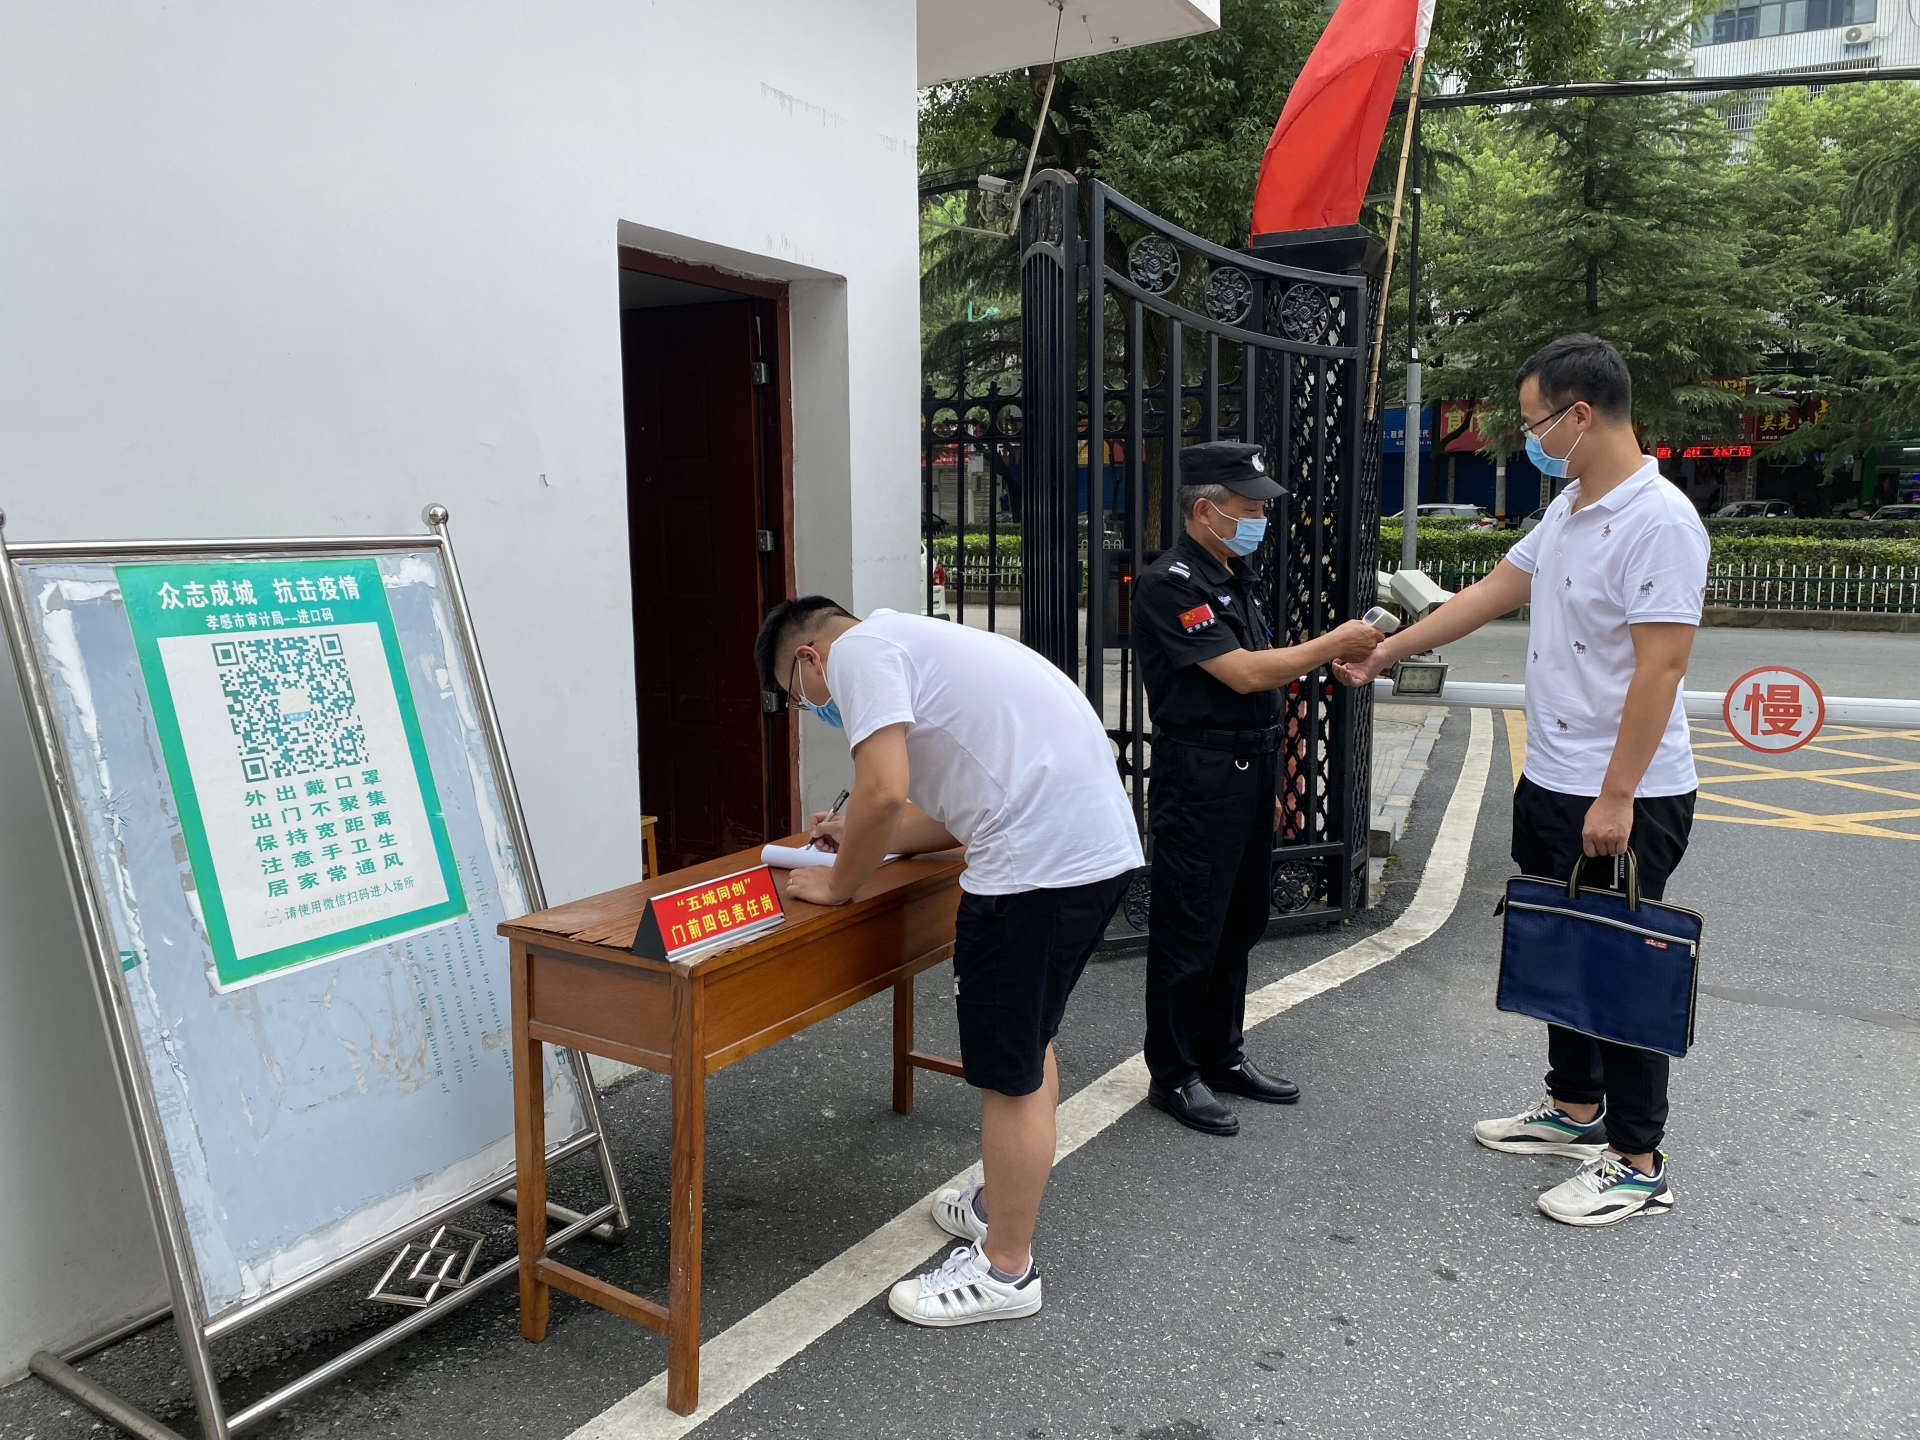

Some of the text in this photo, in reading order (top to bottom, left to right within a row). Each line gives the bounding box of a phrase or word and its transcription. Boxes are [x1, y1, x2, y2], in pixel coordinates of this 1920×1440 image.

[156, 575, 360, 610] 众志成城 抗击疫情
[205, 607, 334, 631] 孝感市审计局--进口码
[1743, 683, 1803, 737] 慢
[244, 769, 381, 807] 外出戴口罩
[251, 790, 387, 830] 出门不聚集
[255, 810, 392, 853] 保持宽距离
[260, 832, 398, 876] 注意手卫生
[267, 852, 404, 898] 居家常通风
[285, 875, 415, 920] 请使用微信扫码进入场所
[468, 855, 490, 916] NOTICE:
[676, 878, 751, 912] “五城同创”
[671, 893, 774, 945] 门前四包责任岗
[468, 913, 486, 967] stallation
[483, 972, 490, 984] to
[487, 990, 503, 1037] directio
[405, 941, 450, 1094] days at the beginning of
[424, 946, 435, 962] off
[430, 968, 440, 987] the
[435, 994, 456, 1053] protective
[453, 1059, 464, 1083] film
[442, 943, 458, 988] Chinese
[455, 995, 470, 1037] curtain
[467, 1044, 479, 1073] wall.
[469, 984, 478, 1007] acc.
[476, 1013, 483, 1024] to
